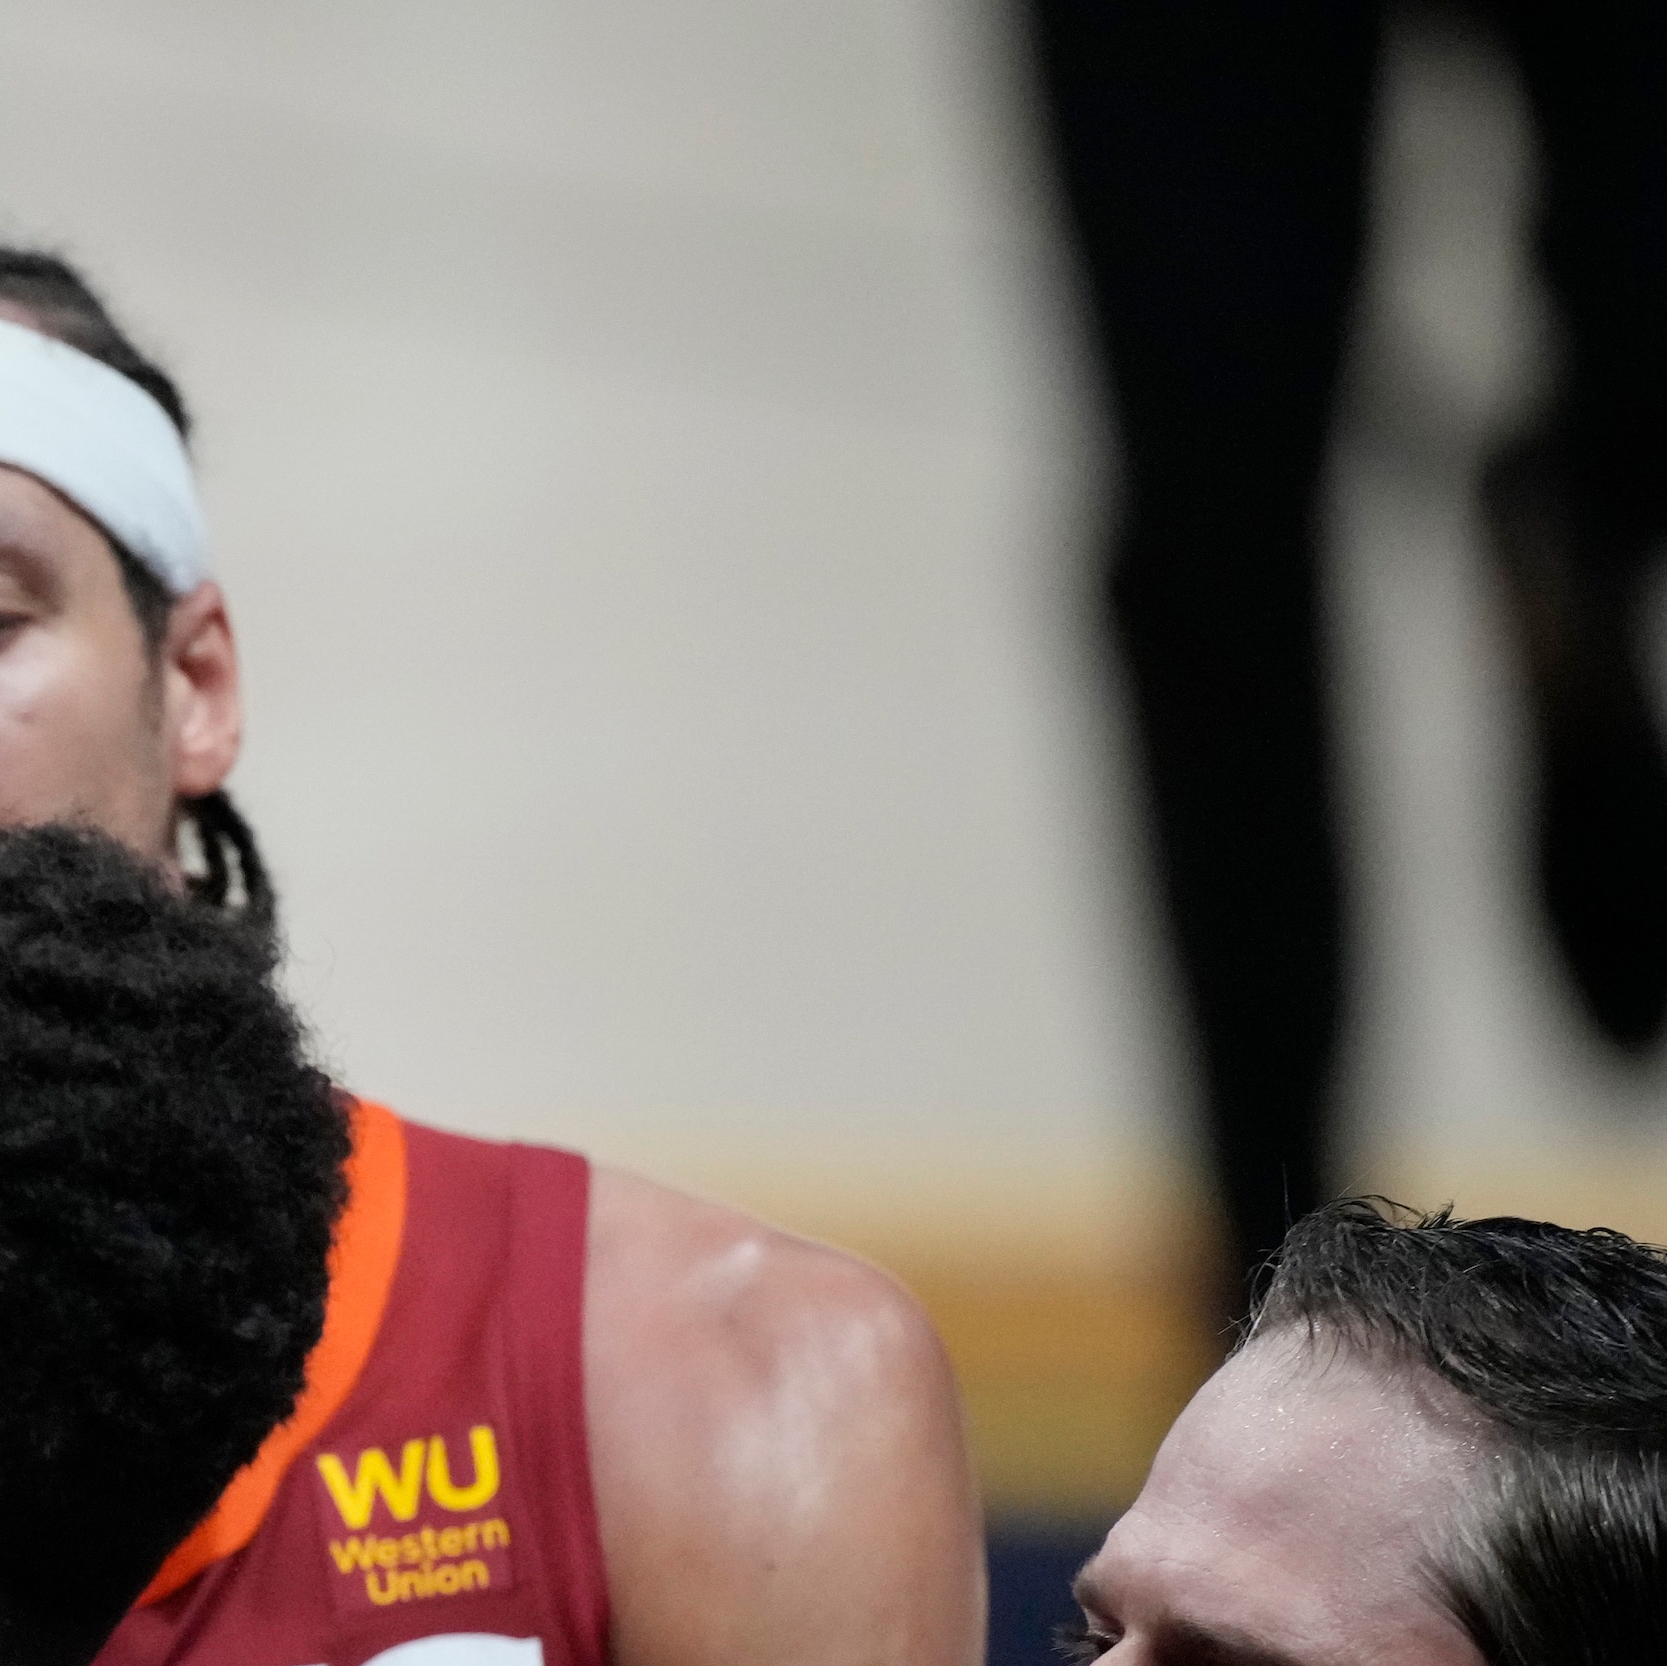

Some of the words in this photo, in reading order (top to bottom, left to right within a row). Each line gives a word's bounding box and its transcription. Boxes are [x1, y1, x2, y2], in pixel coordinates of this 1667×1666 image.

[318, 1425, 500, 1529] WU
[329, 1518, 510, 1574] Western
[367, 1559, 489, 1605] Union
